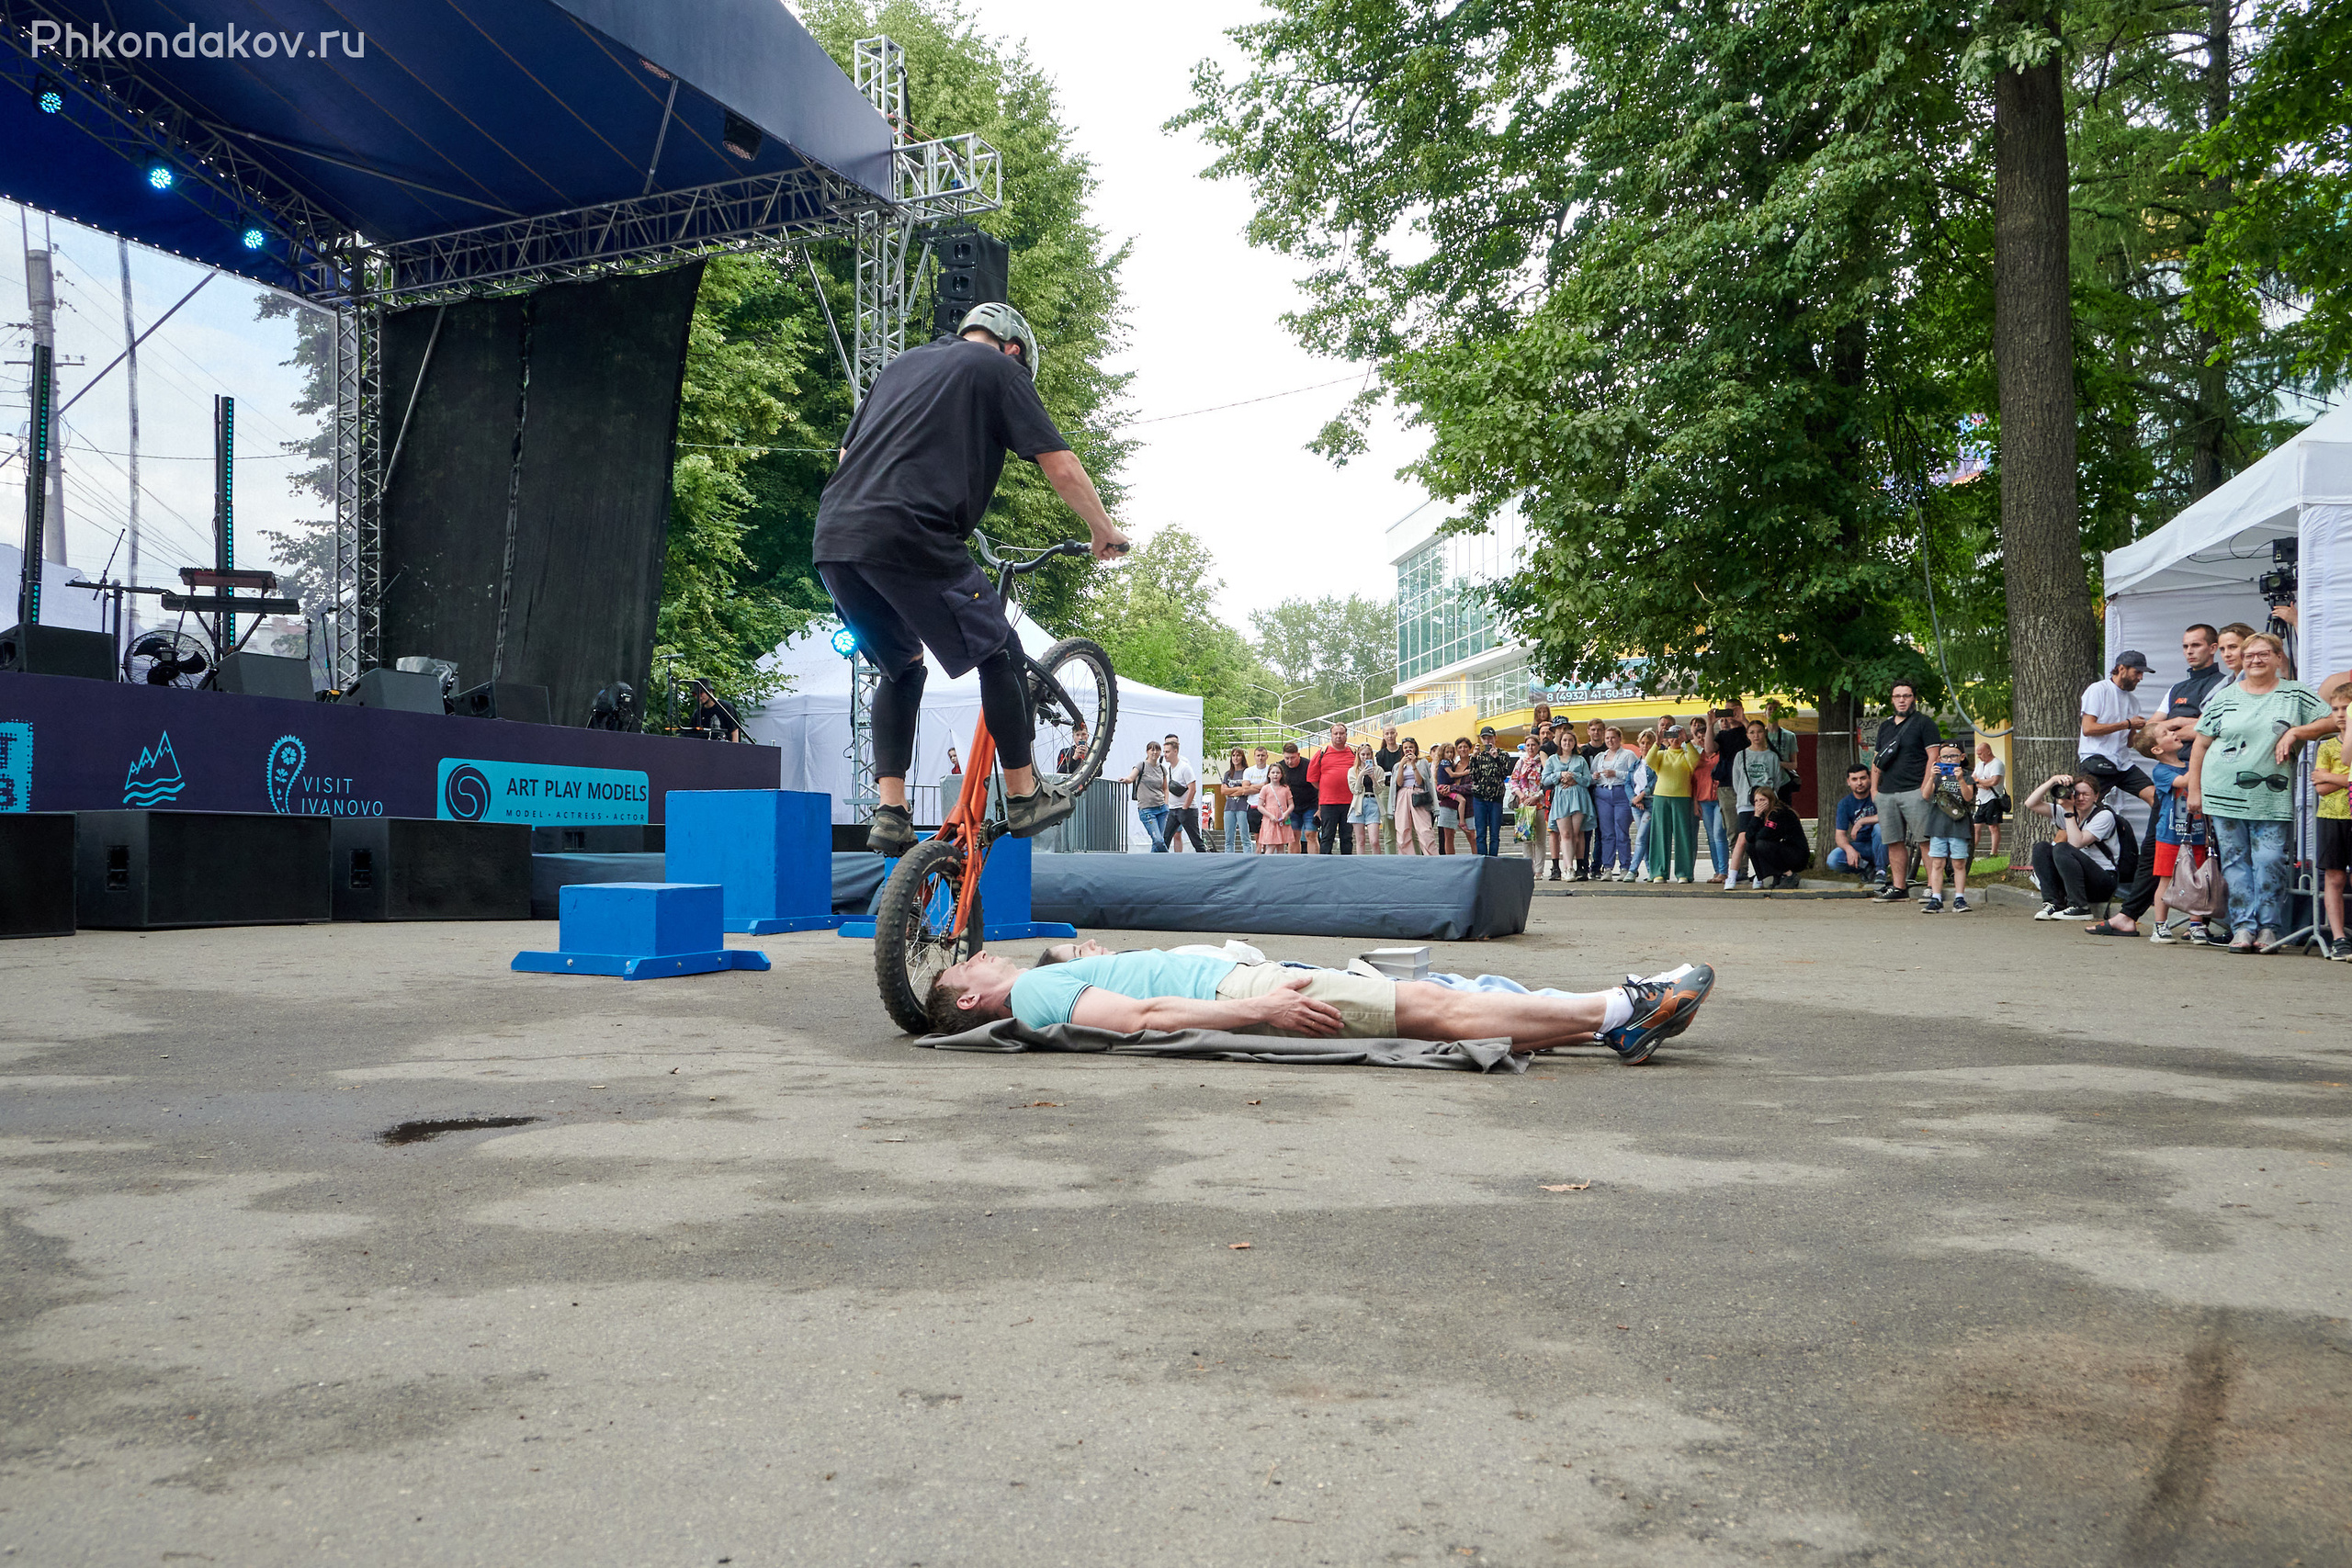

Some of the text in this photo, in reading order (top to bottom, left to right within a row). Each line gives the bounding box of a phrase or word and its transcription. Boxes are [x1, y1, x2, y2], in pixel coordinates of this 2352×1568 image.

[1546, 688, 1634, 704] 8 (4932) 41-60-13
[302, 776, 353, 794] VISIT
[506, 777, 647, 802] ART PLAY MODELS
[301, 797, 383, 817] IVANOVO
[505, 809, 645, 821] MODEL ACTRESS ACTOR
